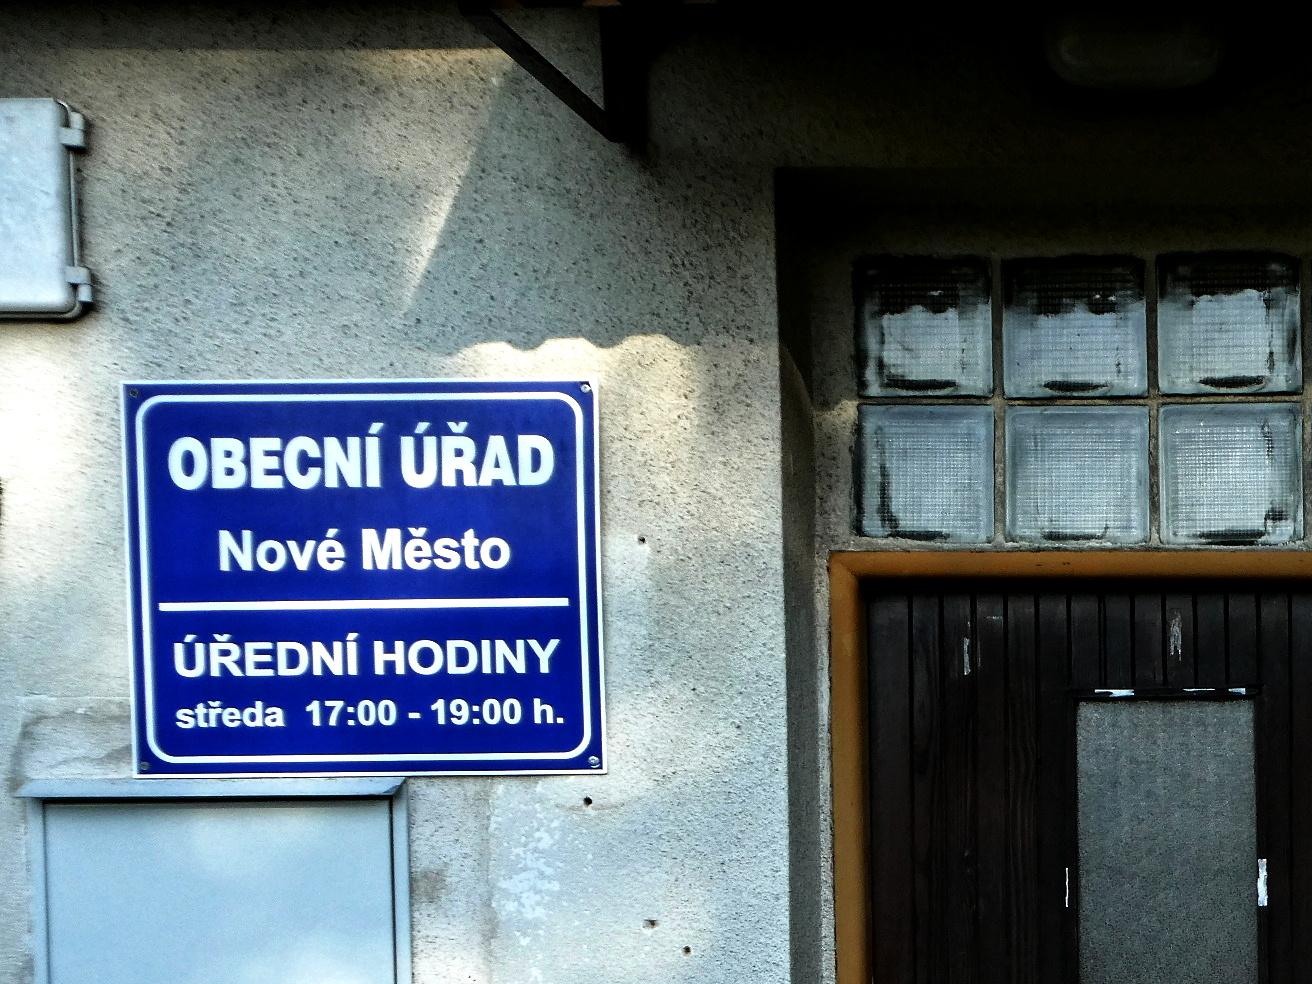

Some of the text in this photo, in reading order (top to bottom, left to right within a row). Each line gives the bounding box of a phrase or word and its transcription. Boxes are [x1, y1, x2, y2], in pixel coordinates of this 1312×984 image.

[167, 421, 555, 490] OBECNÍ ÚŘAD
[218, 527, 511, 572] Nové Město
[173, 633, 560, 678] ÚŘEDNÍ HODINY
[175, 700, 286, 728] středa
[305, 699, 396, 727] 17:00
[430, 698, 522, 725] 19:00
[533, 698, 565, 725] h.
